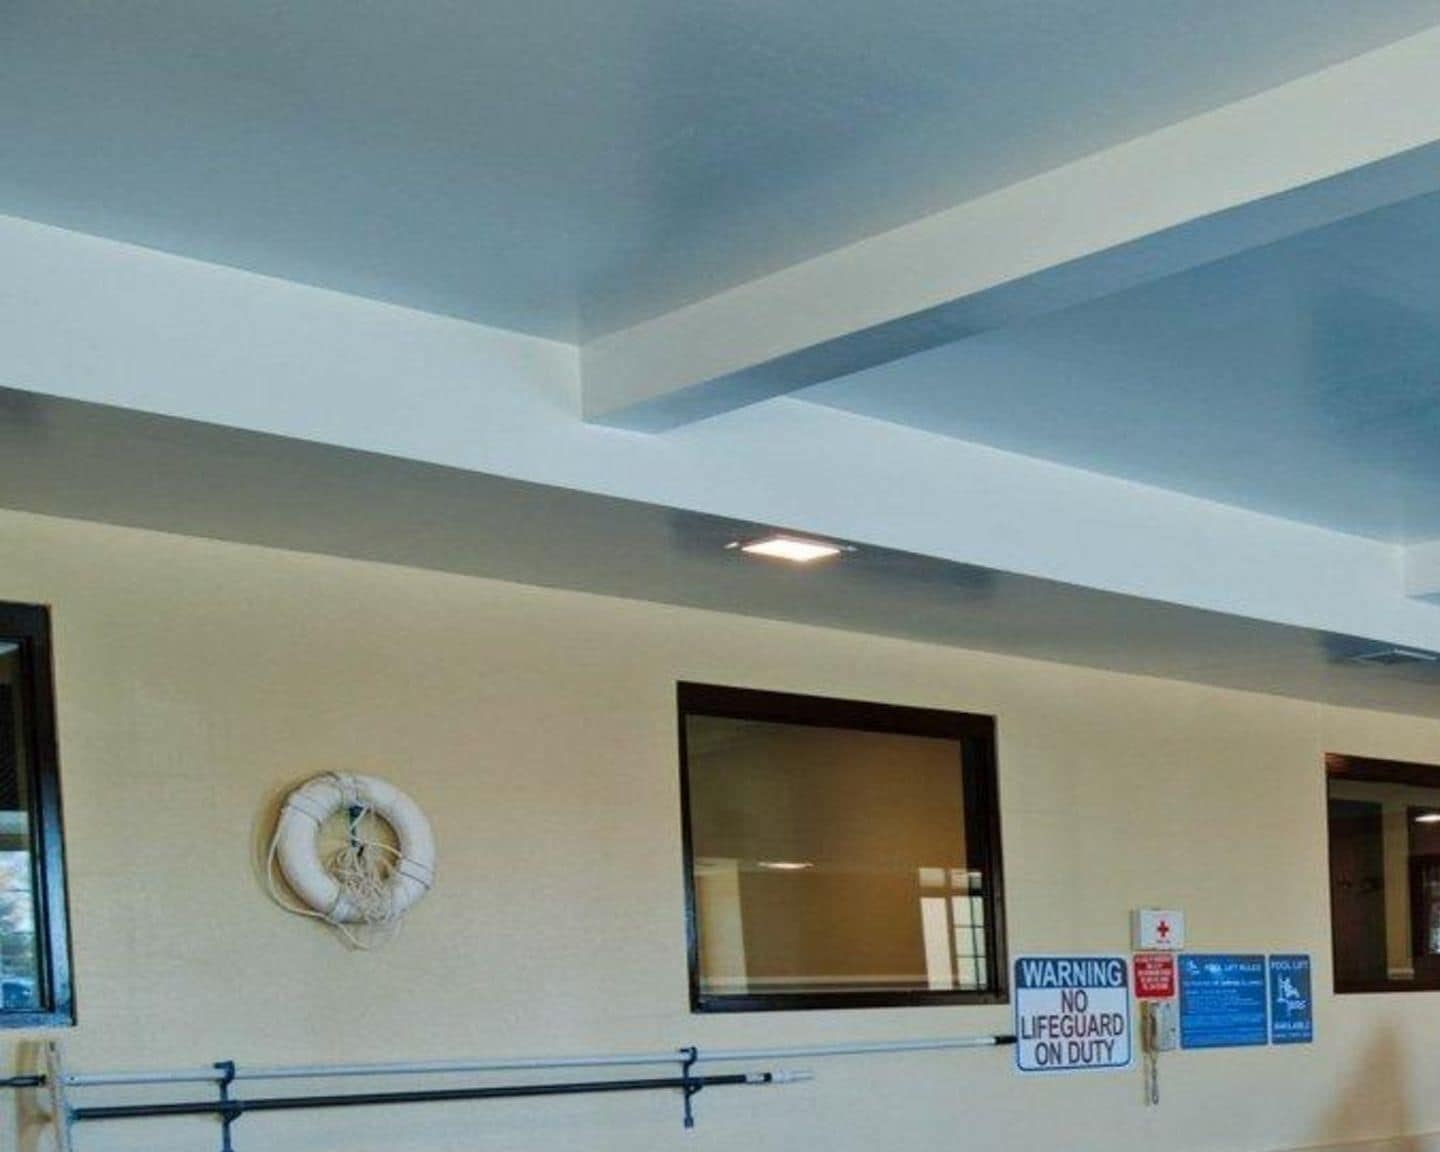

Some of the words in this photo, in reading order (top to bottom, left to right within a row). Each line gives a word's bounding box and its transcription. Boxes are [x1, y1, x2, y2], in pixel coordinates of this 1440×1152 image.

[1022, 960, 1121, 987] WARNING
[1062, 989, 1088, 1013] NO
[1021, 1013, 1124, 1039] LIFEGUARD
[1035, 1042, 1062, 1065] ON
[1068, 1039, 1114, 1063] DUTY
